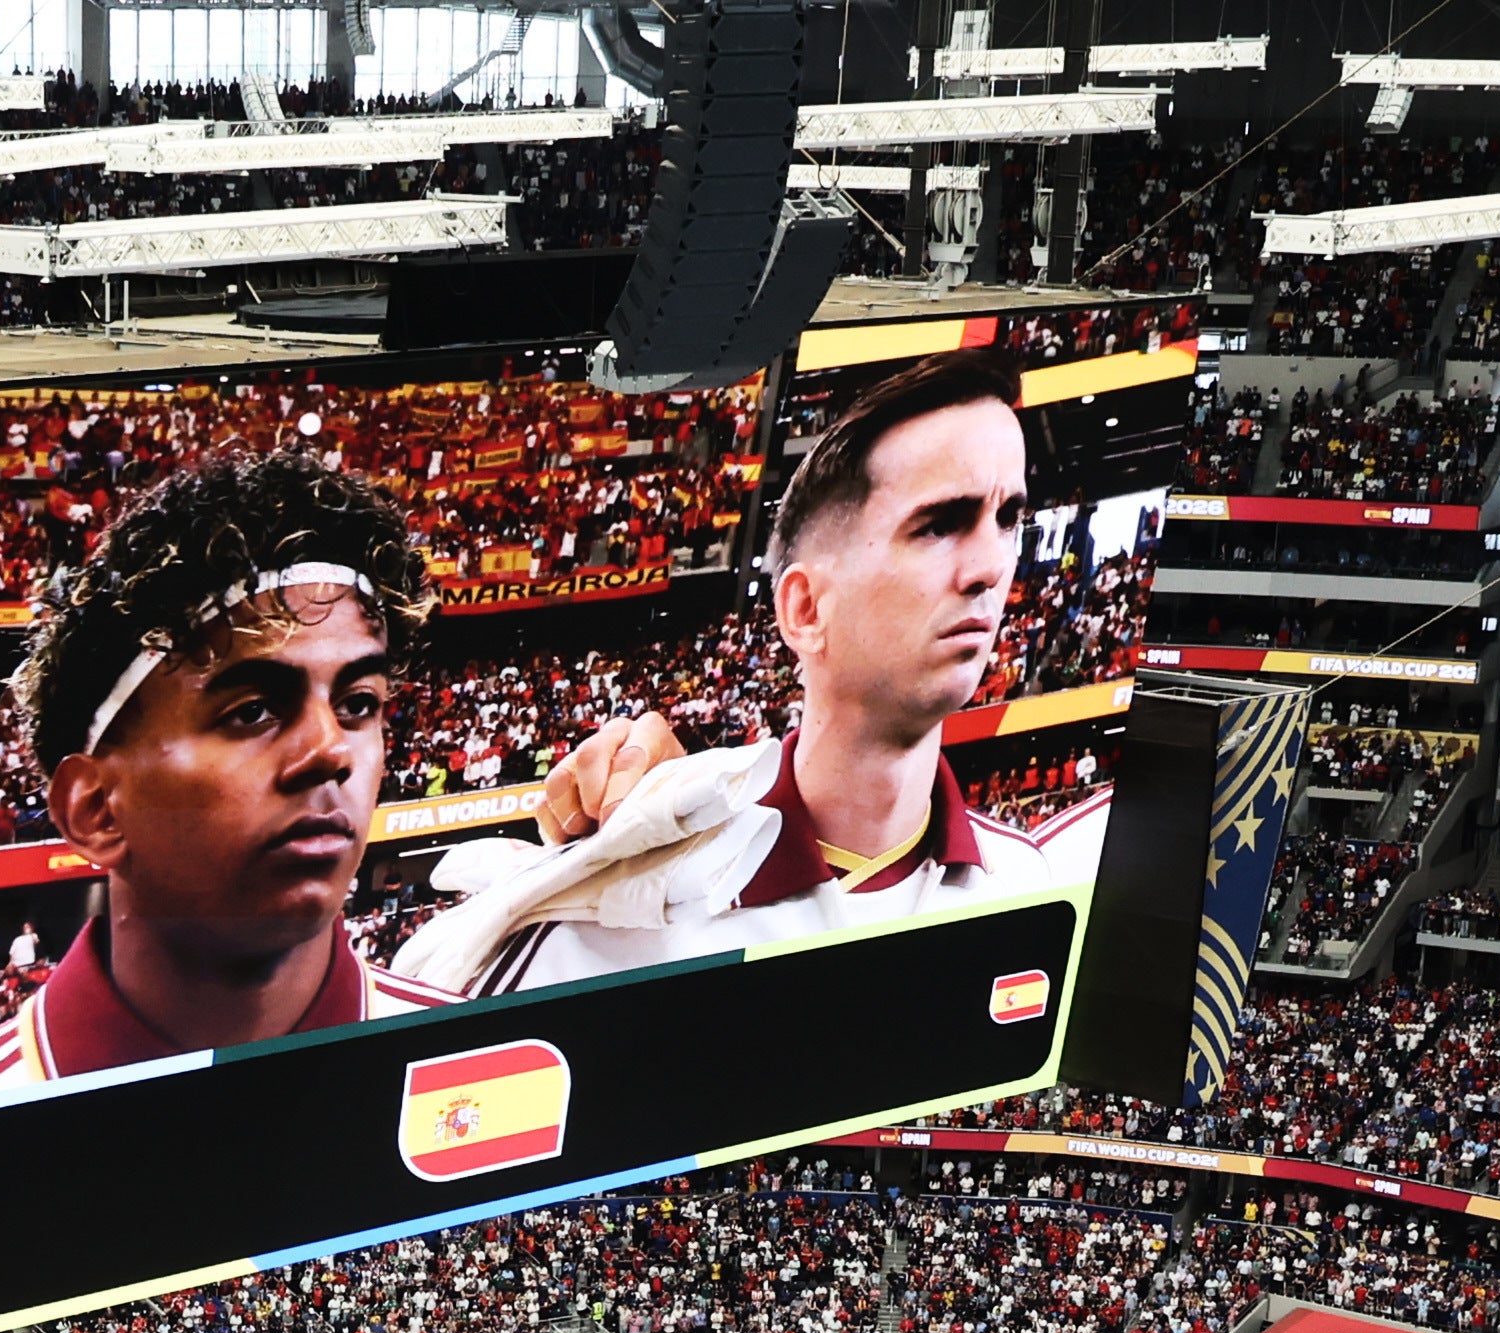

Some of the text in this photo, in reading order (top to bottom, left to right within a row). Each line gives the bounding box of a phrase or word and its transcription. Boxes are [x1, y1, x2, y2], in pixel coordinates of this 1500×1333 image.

[1392, 507, 1430, 524] SPAIN
[1146, 650, 1181, 665] SPAIN
[1310, 657, 1344, 673] FIFA
[1345, 658, 1404, 676] WORLD
[1405, 660, 1437, 678] CUP
[386, 809, 437, 834] FIFA
[438, 795, 520, 822] WORLD
[901, 1132, 931, 1146] SPAIN
[1067, 1140, 1097, 1154] FIFA
[1097, 1143, 1147, 1159] WORLD
[1147, 1148, 1176, 1162] CUP
[1374, 1180, 1401, 1197] SPAIN
